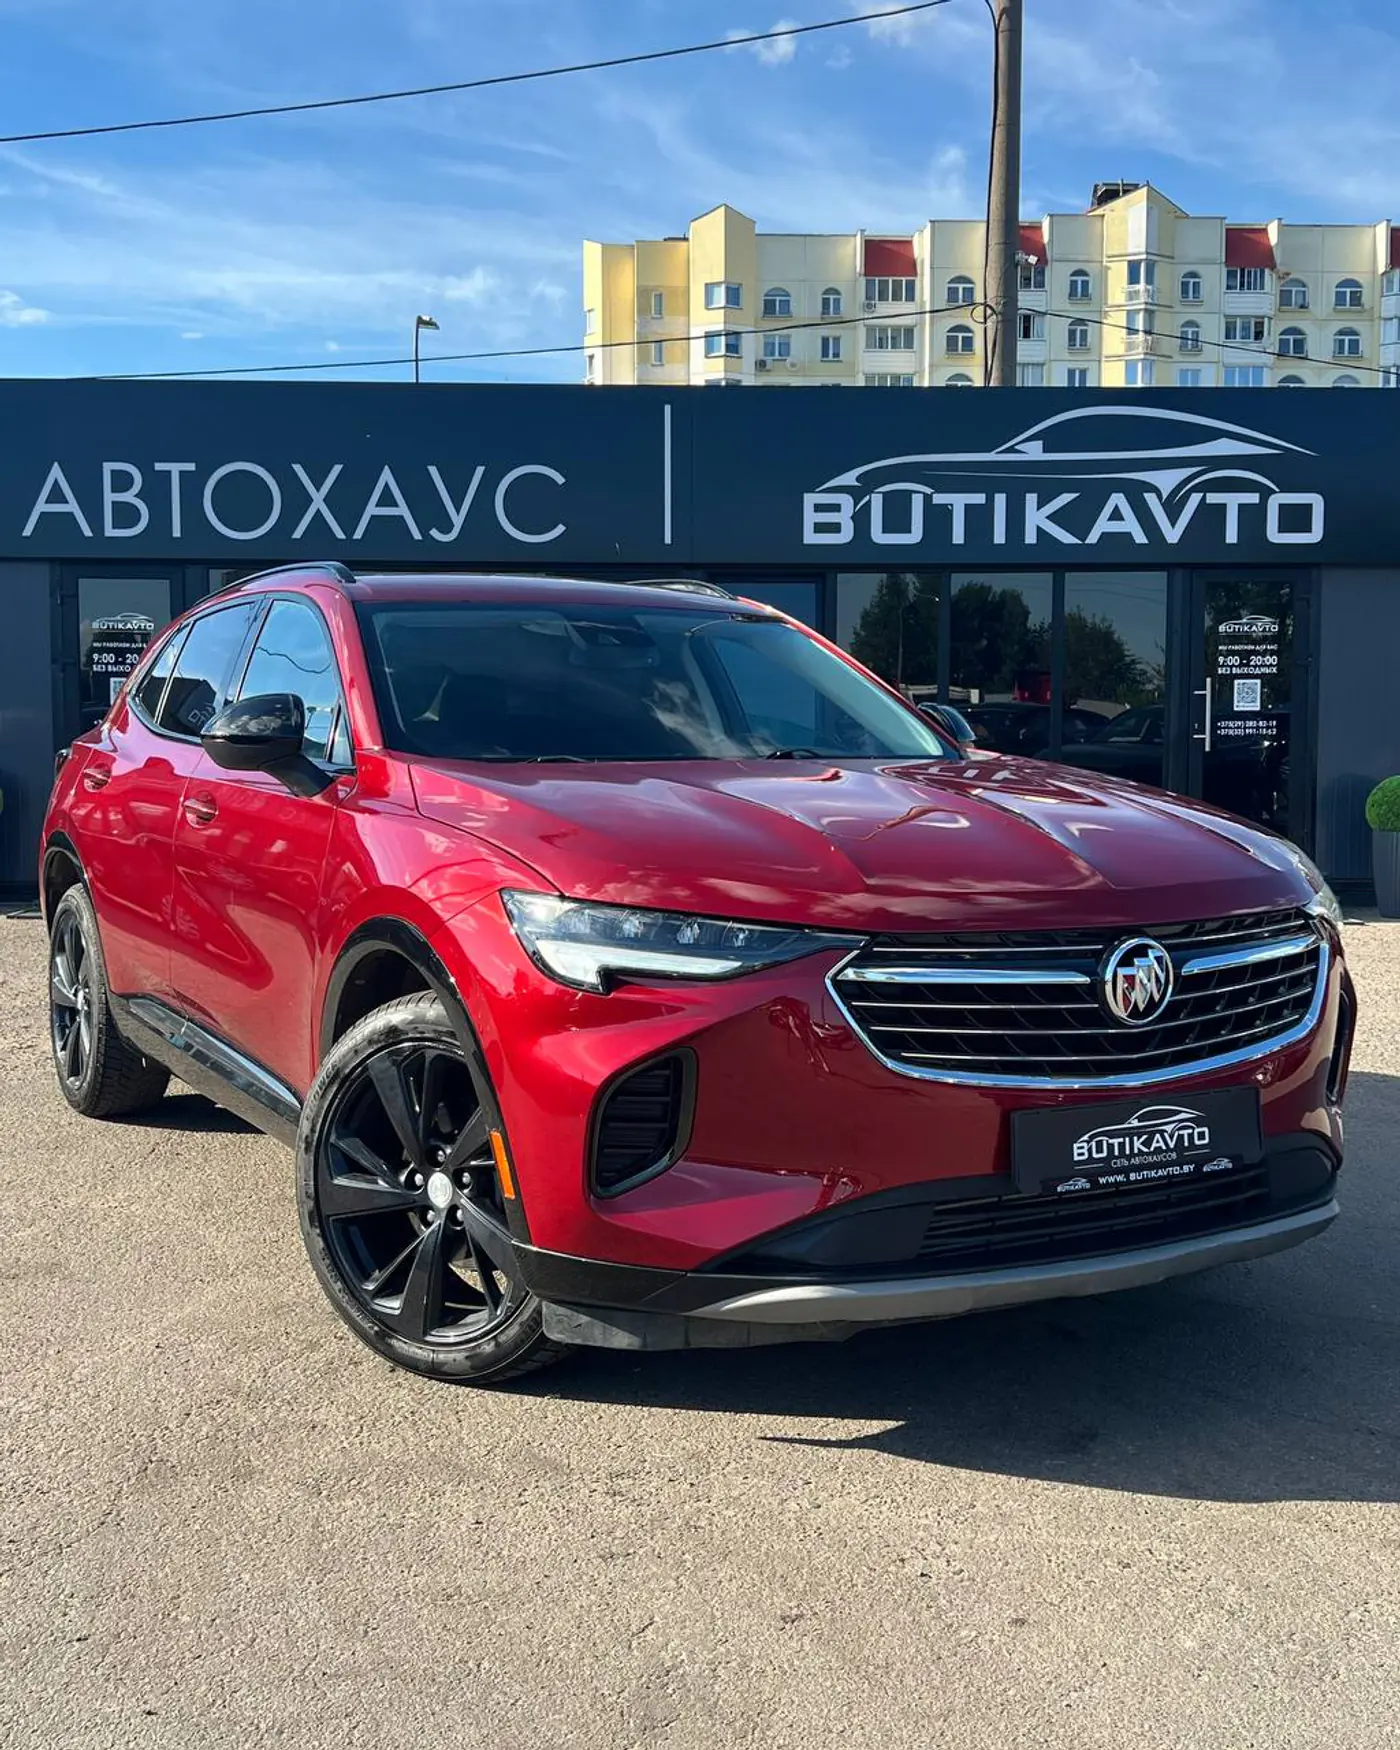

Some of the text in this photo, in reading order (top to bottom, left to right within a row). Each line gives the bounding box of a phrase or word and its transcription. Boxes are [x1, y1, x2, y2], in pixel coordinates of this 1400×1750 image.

[21, 460, 567, 544] АВТОХАУС
[802, 491, 1326, 545] BUTIKAVTO
[1218, 624, 1279, 633] BUTIKAVTO
[92, 653, 115, 663] 9:00
[1218, 656, 1240, 666] 9:00
[1249, 655, 1278, 666] 20:00
[1072, 1126, 1210, 1161] BUTIKAVTO
[1111, 1151, 1178, 1168] СЕТЬ АВТОХАУСОВ
